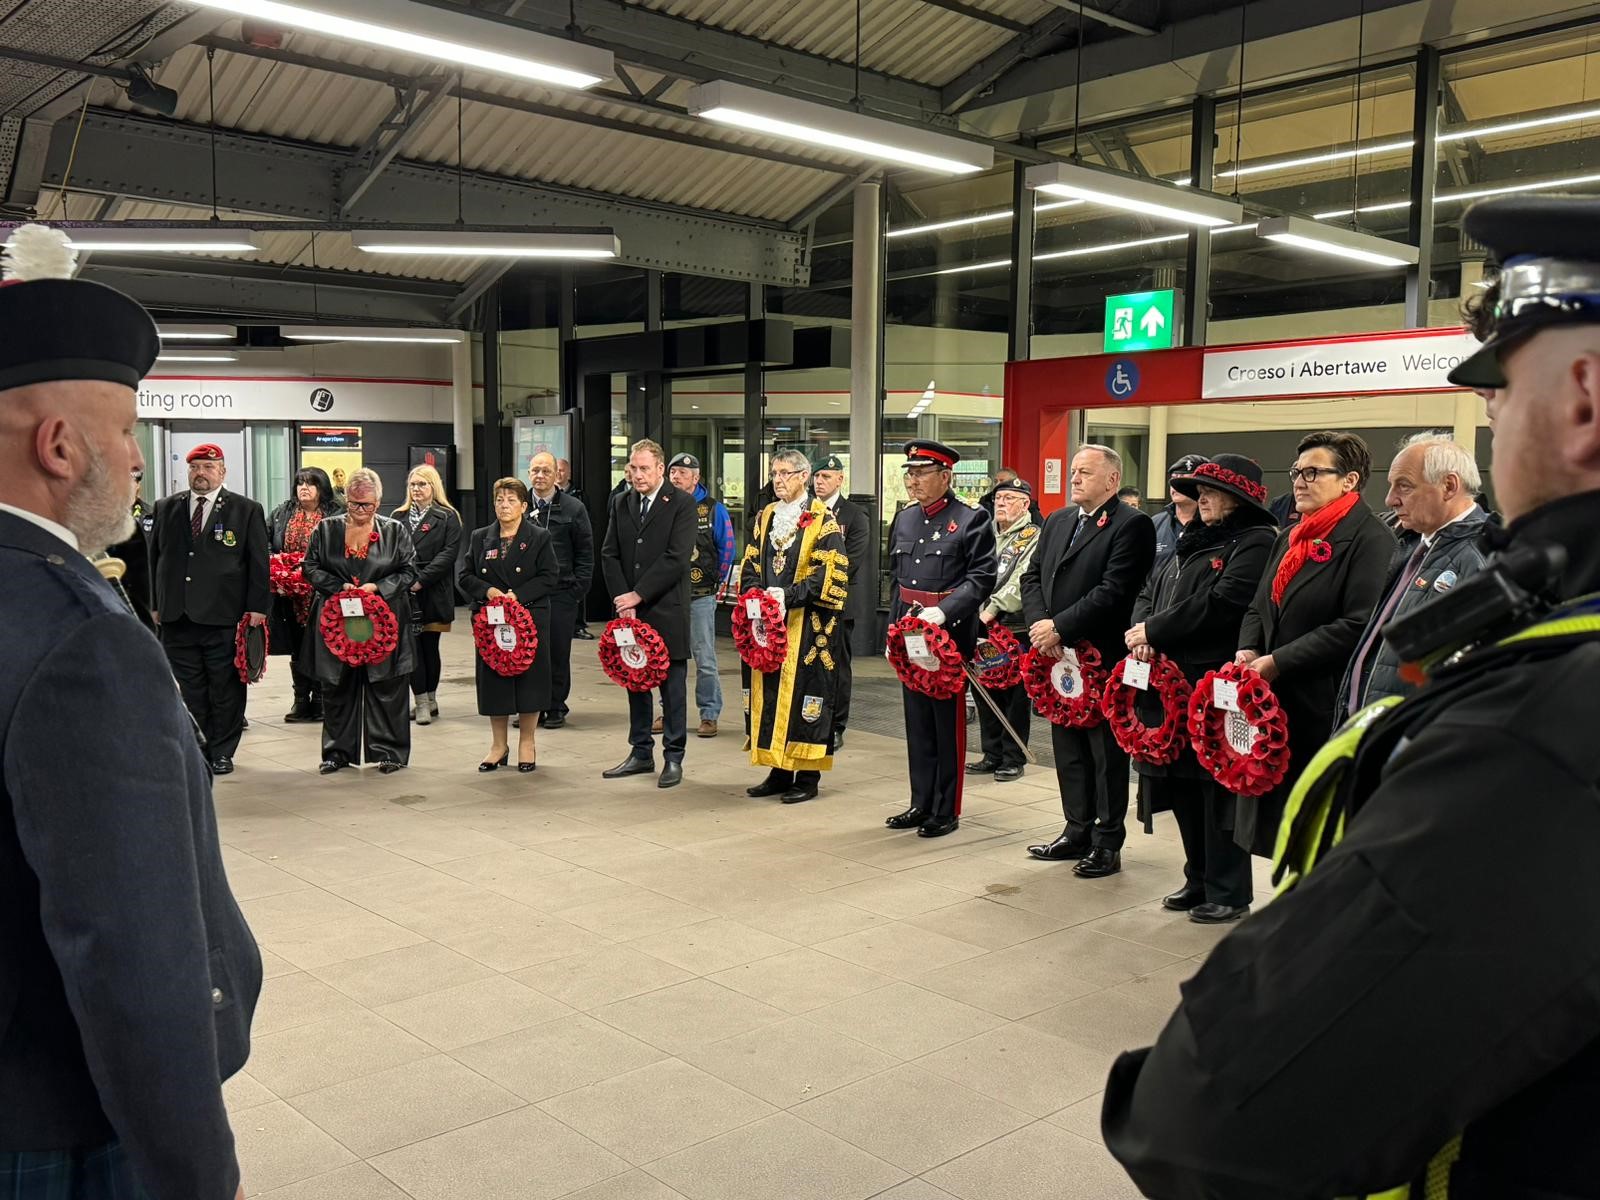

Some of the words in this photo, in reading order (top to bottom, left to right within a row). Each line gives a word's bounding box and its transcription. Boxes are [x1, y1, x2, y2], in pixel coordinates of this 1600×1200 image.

[1227, 365, 1286, 382] Croeso
[1290, 362, 1295, 378] i
[1300, 360, 1387, 378] Abertawe
[1402, 353, 1469, 371] Welco
[138, 390, 174, 412] ting
[181, 394, 233, 408] room
